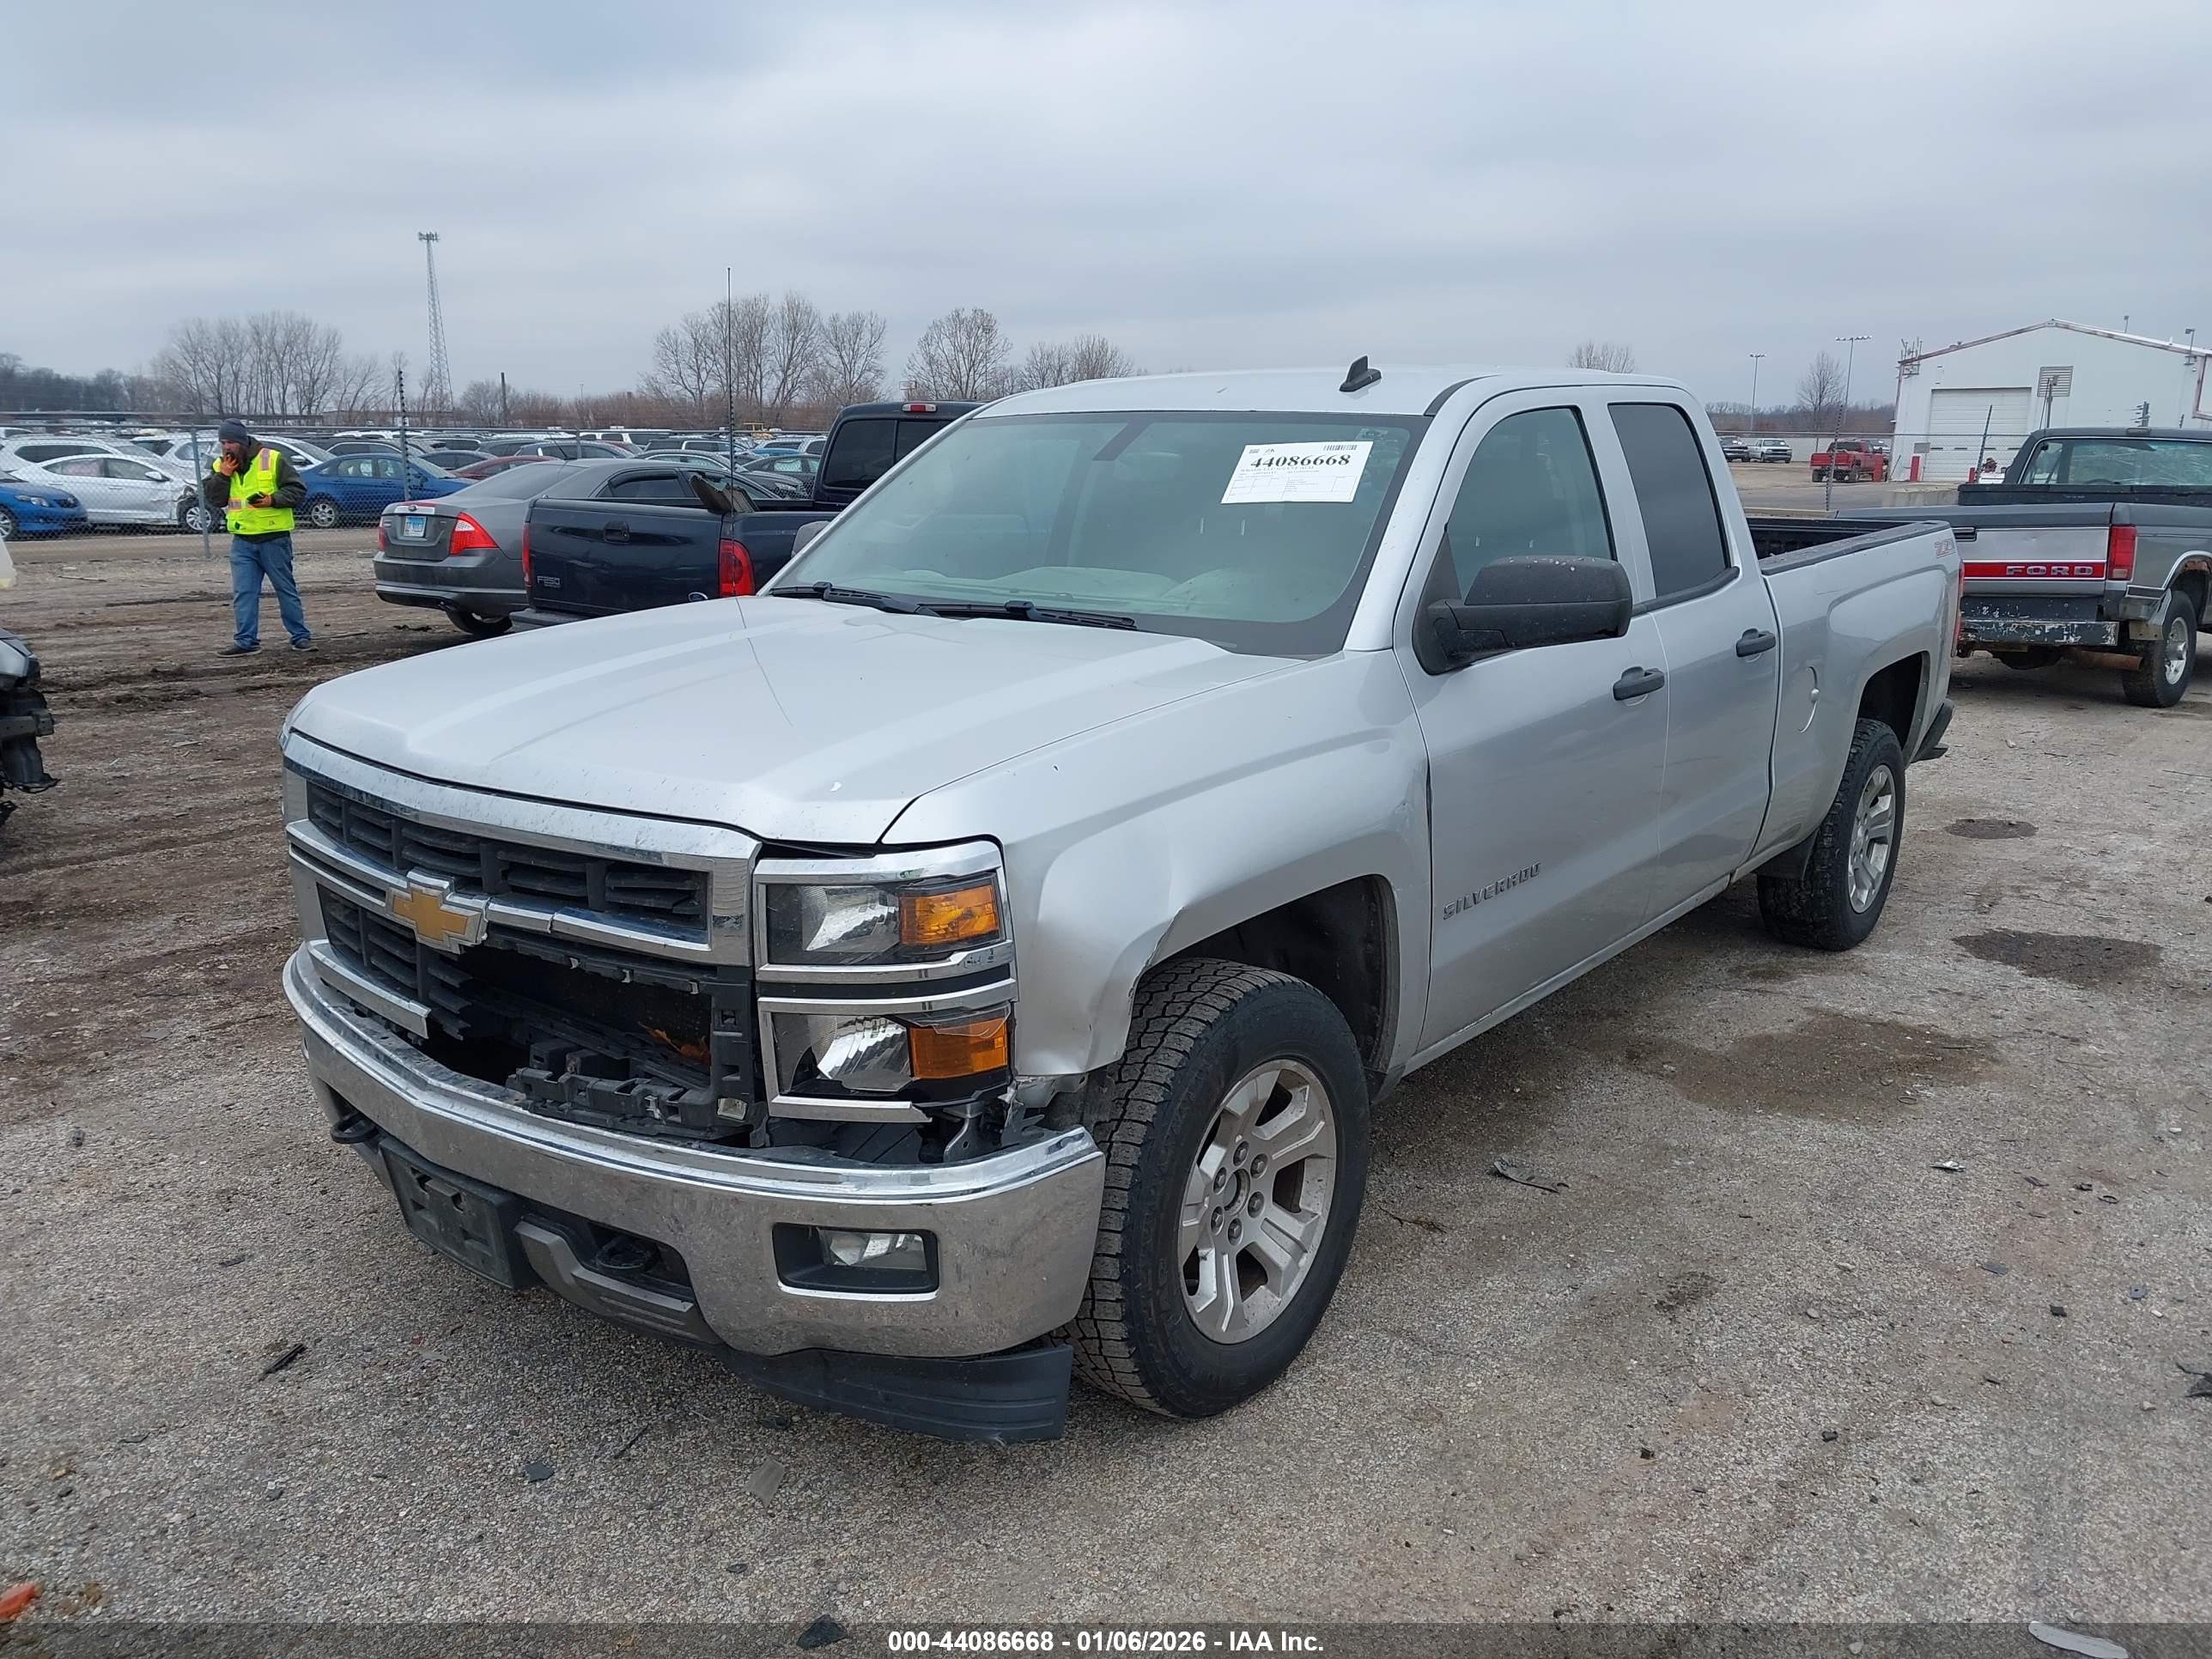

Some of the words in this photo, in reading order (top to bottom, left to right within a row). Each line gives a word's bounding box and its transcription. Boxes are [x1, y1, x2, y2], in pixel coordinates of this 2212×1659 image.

[1250, 454, 1351, 468] 44086668
[2005, 565, 2094, 576] FORD
[1443, 861, 1541, 921] SILVERADO
